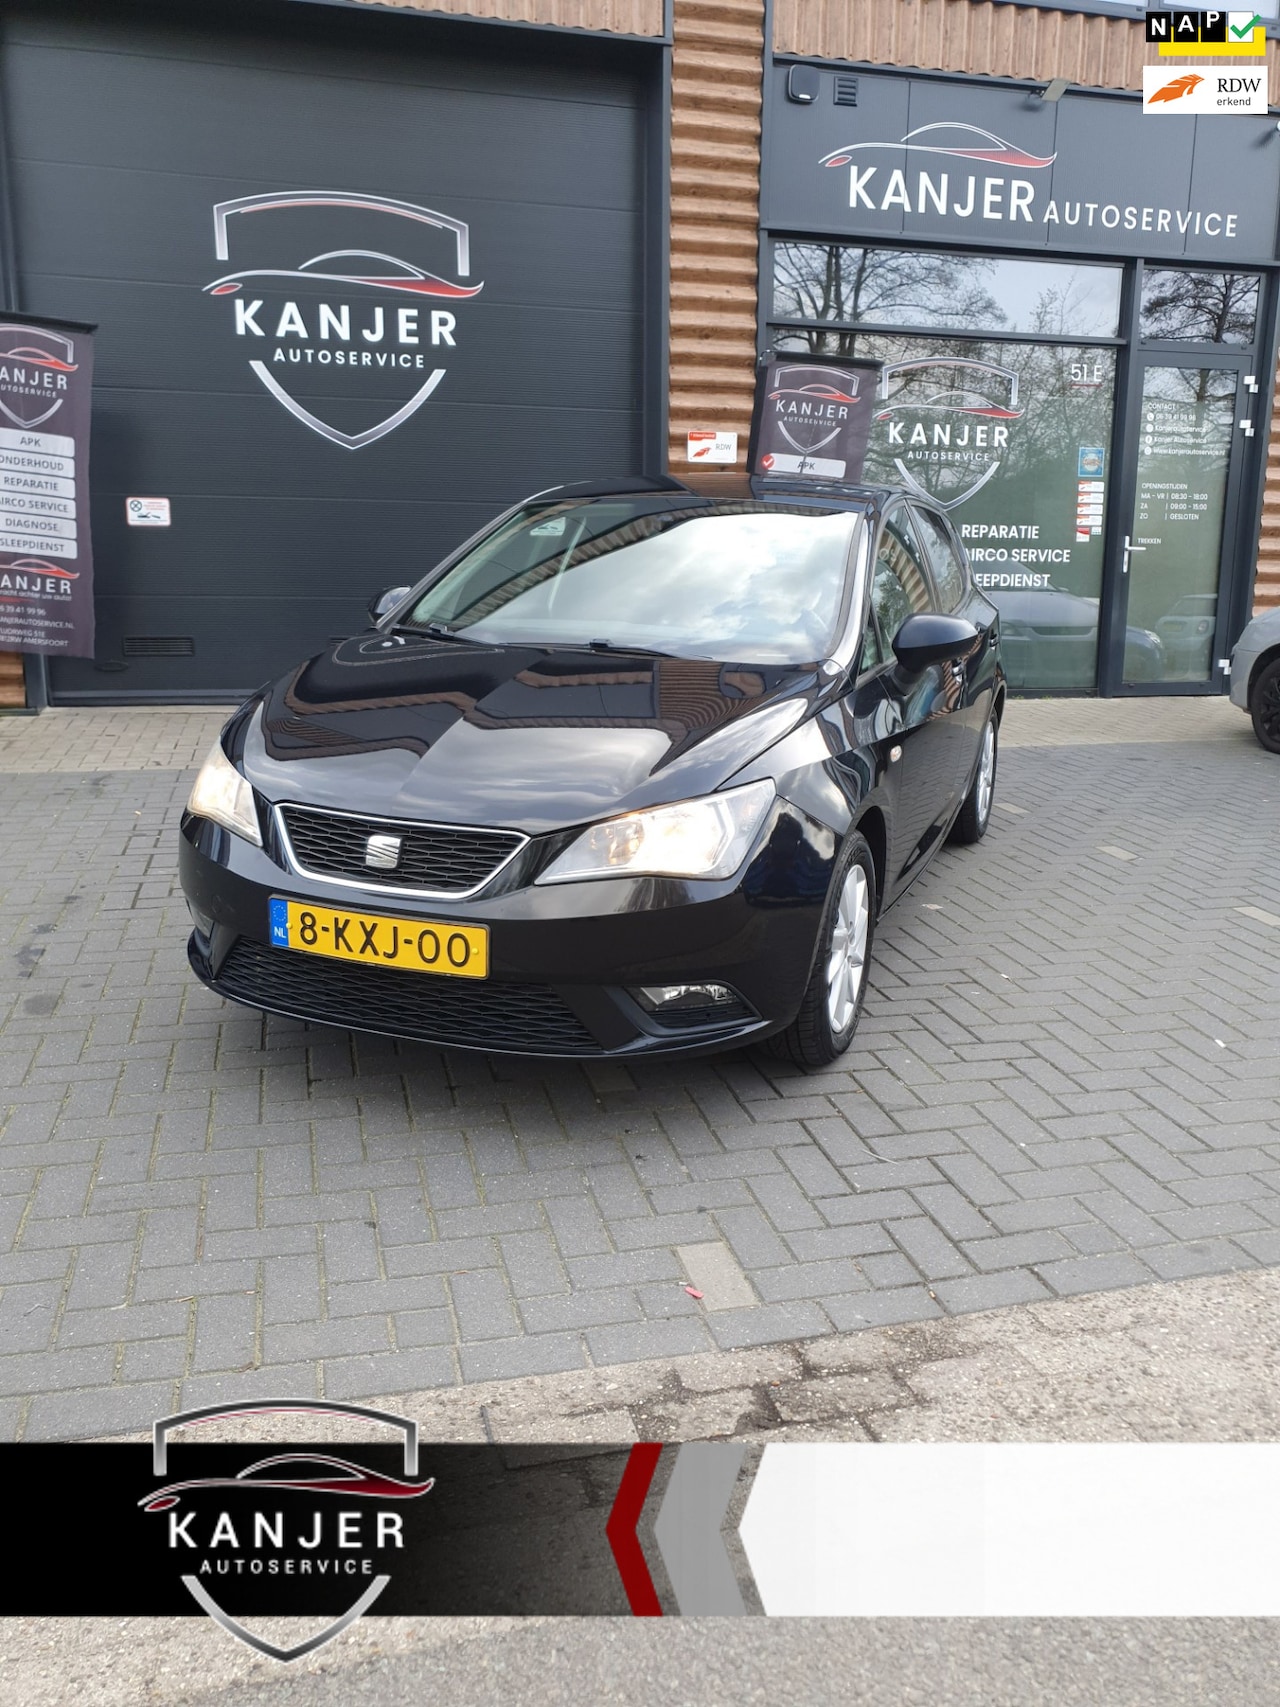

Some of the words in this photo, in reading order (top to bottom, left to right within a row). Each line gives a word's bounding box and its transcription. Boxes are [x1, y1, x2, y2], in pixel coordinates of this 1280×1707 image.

[849, 165, 1035, 222] KANJER
[1043, 200, 1238, 237] AUTOSERVICE
[235, 299, 457, 346] KANJER
[273, 348, 425, 368] AUTOSERVICE
[0, 366, 68, 390] ANJER
[1071, 364, 1087, 381] 51
[1094, 366, 1102, 381] E
[0, 384, 57, 398] UTOSERVICE
[776, 399, 848, 419] KANJER
[1148, 402, 1176, 410] CONTACT
[783, 416, 837, 427] AUTOSERVICE
[20, 436, 41, 447] APK
[888, 422, 1009, 447] KANJER
[716, 443, 732, 451] RDW
[0, 455, 64, 471] ONDERHOUD
[907, 451, 990, 462] AUTOSERVICE
[4, 476, 59, 491] REPARATIE
[1156, 492, 1165, 500] VR
[0, 497, 26, 508] IRCO
[28, 500, 69, 513] SERVICE
[1140, 502, 1148, 510] ZA
[1139, 512, 1149, 520] ZO
[5, 518, 59, 532] DIAGNOSE
[961, 524, 1040, 539] REPARATIE
[1011, 549, 1071, 563] SERVICE
[0, 574, 72, 594] ANJER
[974, 573, 1051, 587] EEPDIENST
[273, 926, 287, 939] NL
[299, 911, 471, 968] 8-KXJ-00
